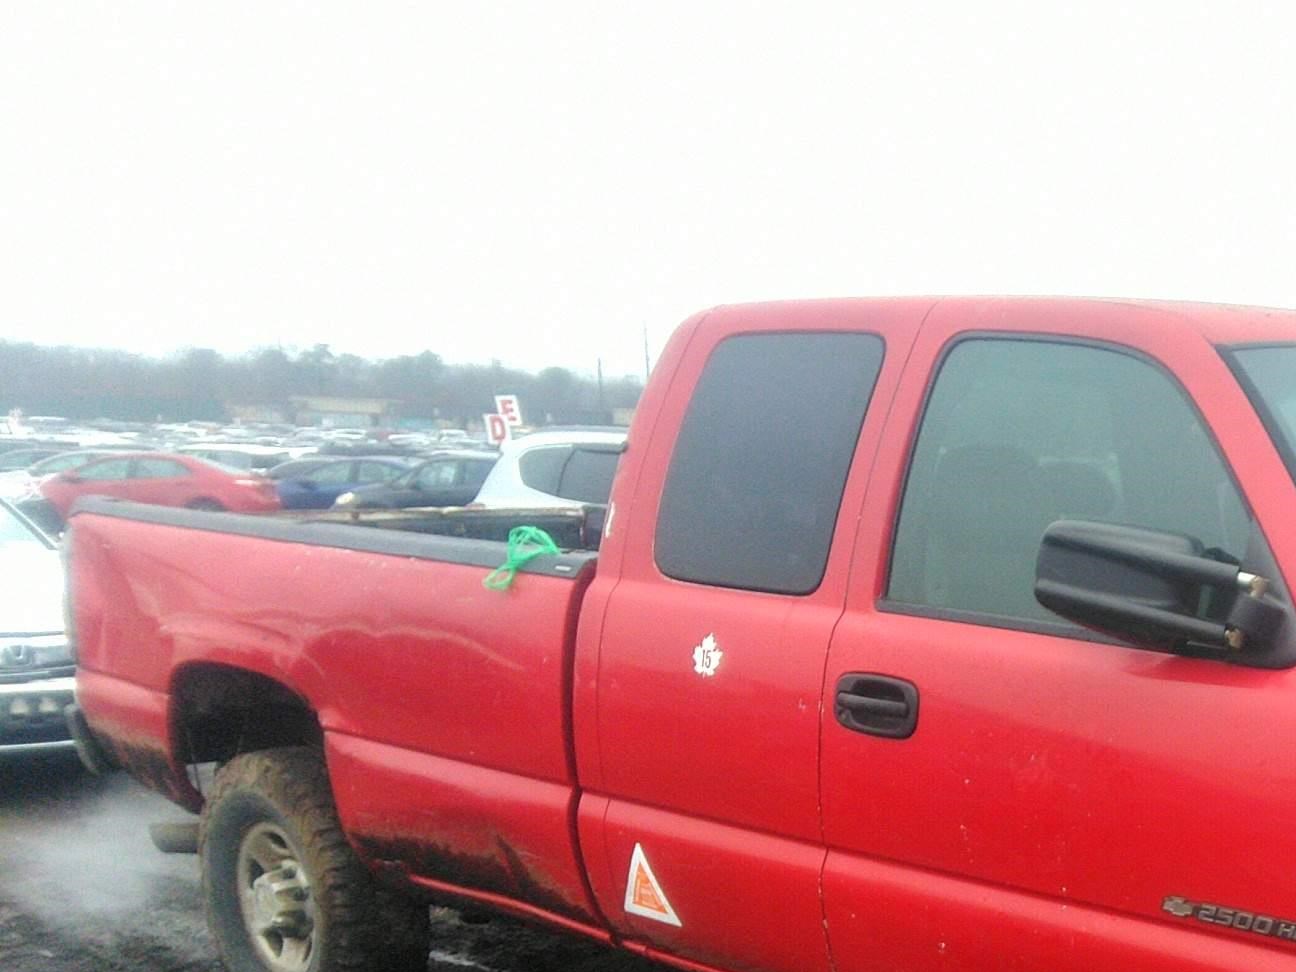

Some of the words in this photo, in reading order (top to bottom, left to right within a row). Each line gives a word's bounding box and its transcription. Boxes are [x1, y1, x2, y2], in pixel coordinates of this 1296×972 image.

[500, 400, 517, 421] E
[489, 415, 506, 440] D
[702, 649, 712, 669] 15
[1198, 903, 1274, 935] 2500
